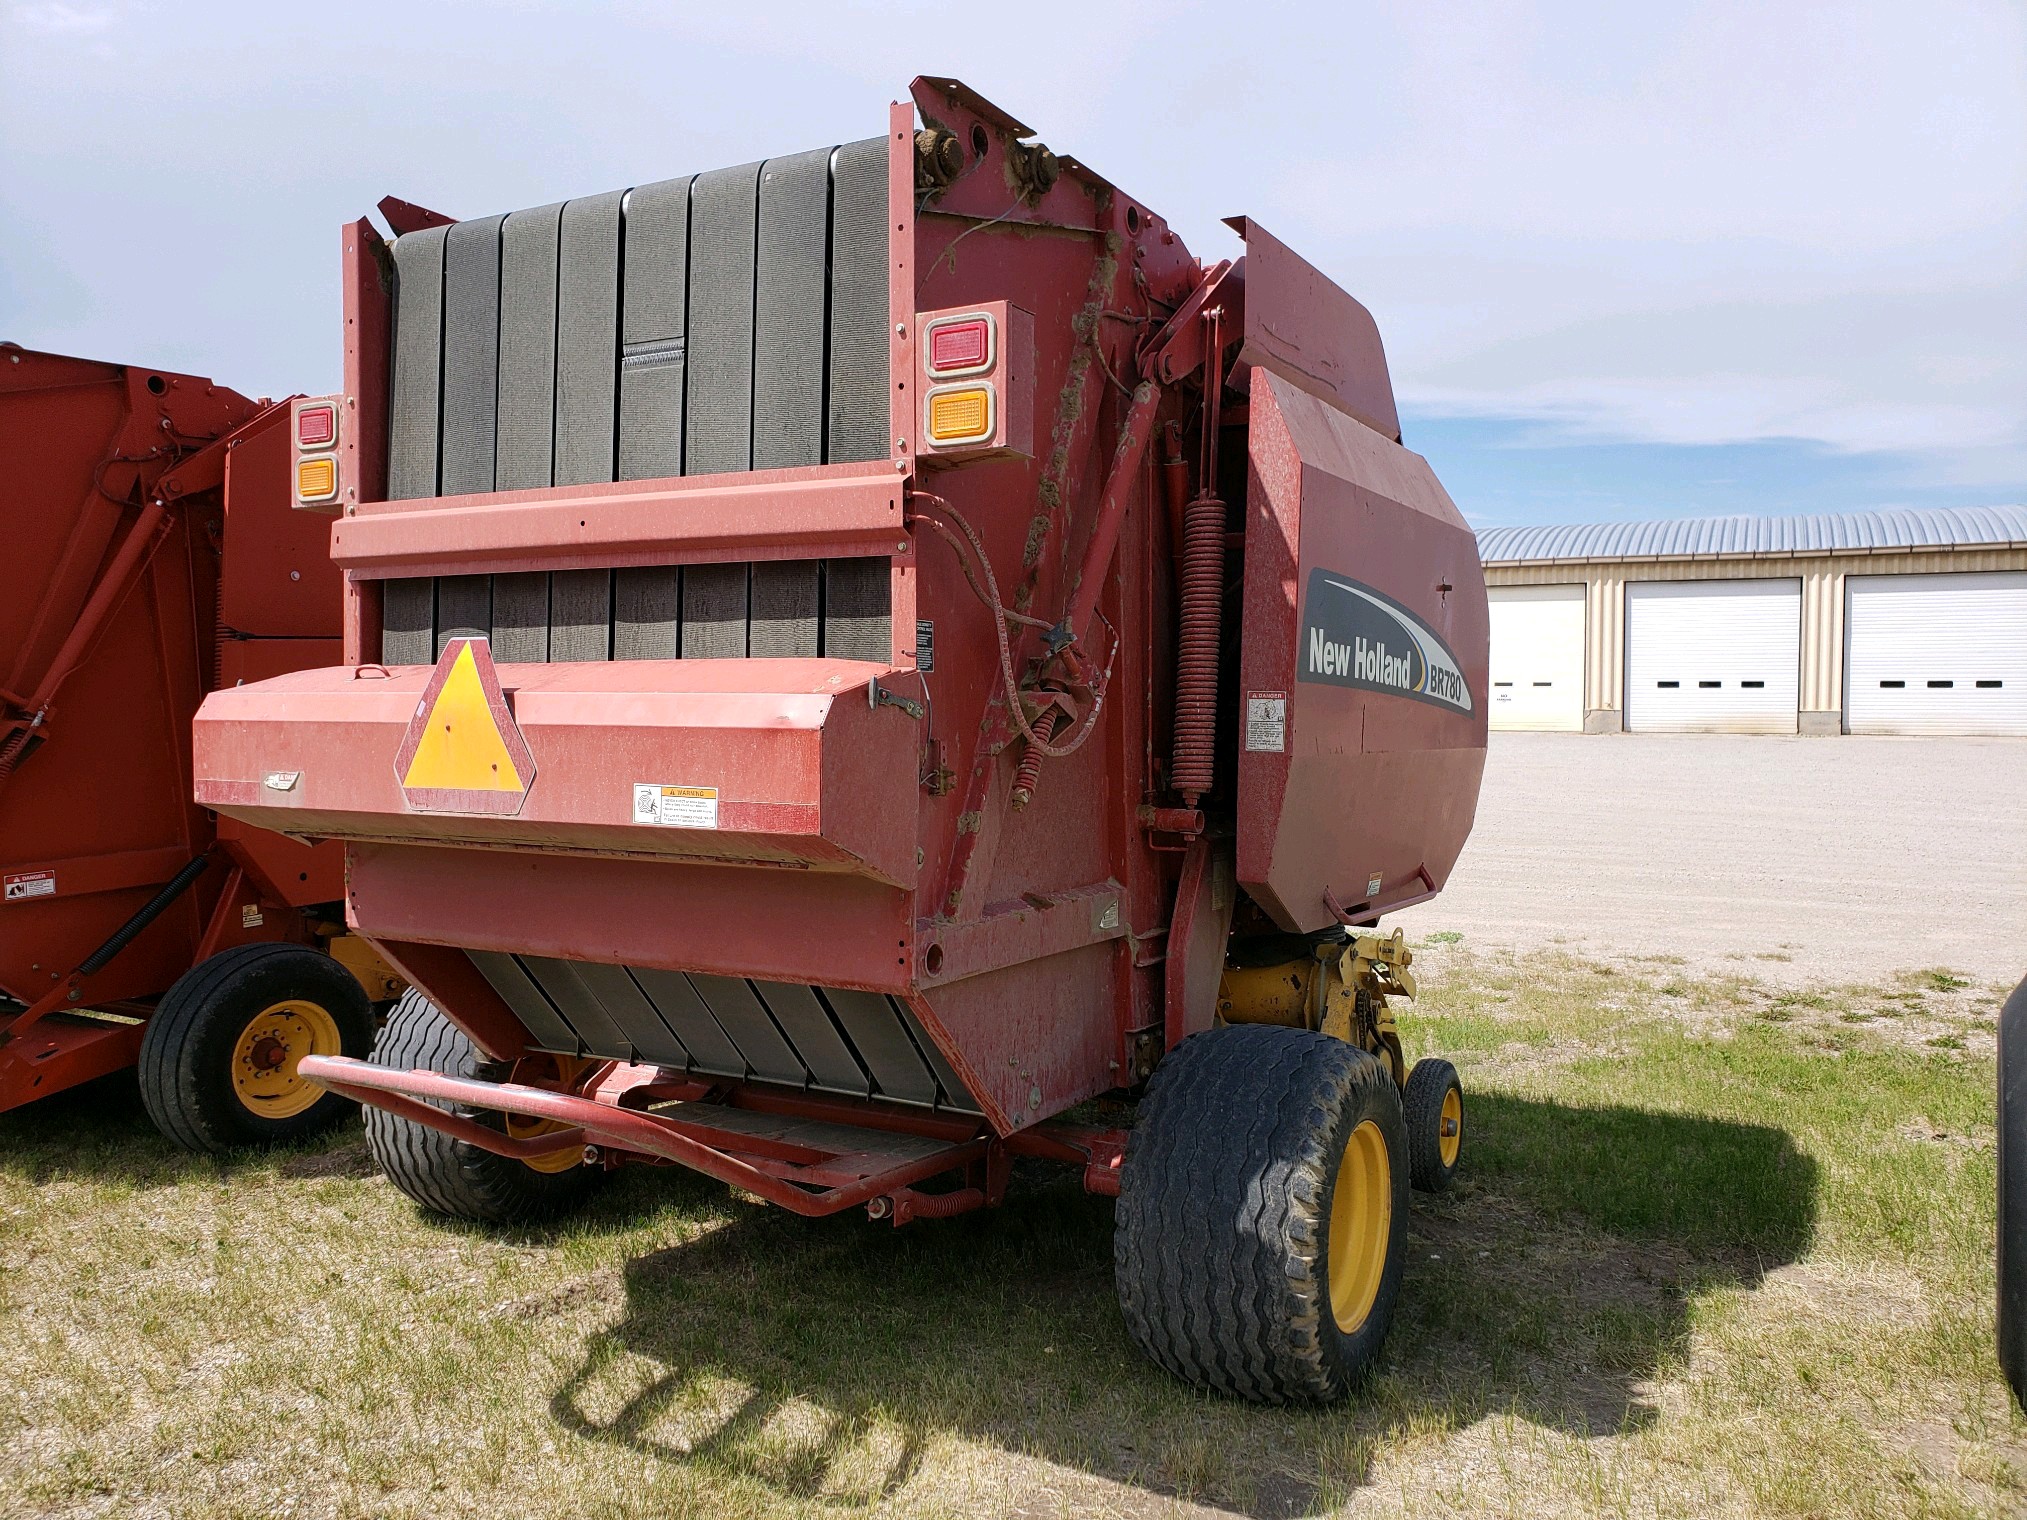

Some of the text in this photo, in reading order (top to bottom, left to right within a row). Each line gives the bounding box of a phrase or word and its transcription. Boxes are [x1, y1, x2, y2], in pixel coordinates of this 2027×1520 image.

[1309, 627, 1462, 702] New Holland BR780
[677, 789, 705, 797] WARNING
[21, 873, 46, 881] DANGER
